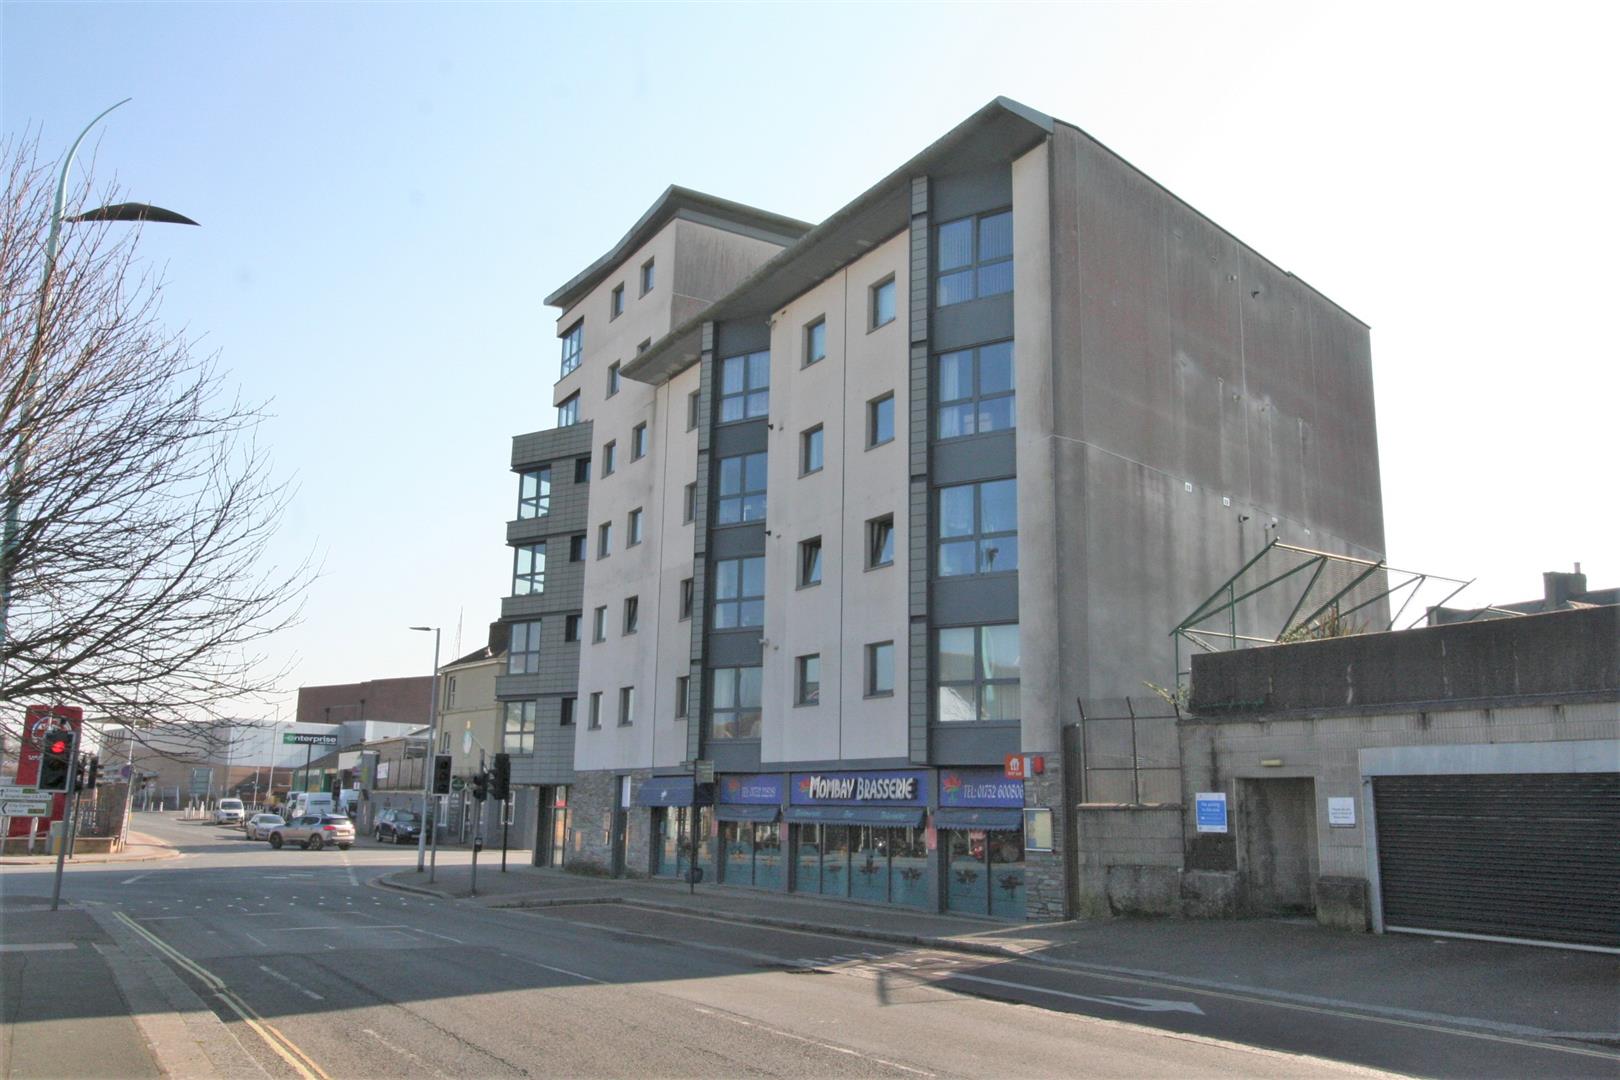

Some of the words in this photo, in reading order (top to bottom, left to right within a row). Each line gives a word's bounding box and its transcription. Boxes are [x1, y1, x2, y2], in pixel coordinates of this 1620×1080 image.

[284, 735, 337, 743] enterprise
[809, 776, 855, 799] MOMBAY
[856, 777, 913, 800] BRASSERIE
